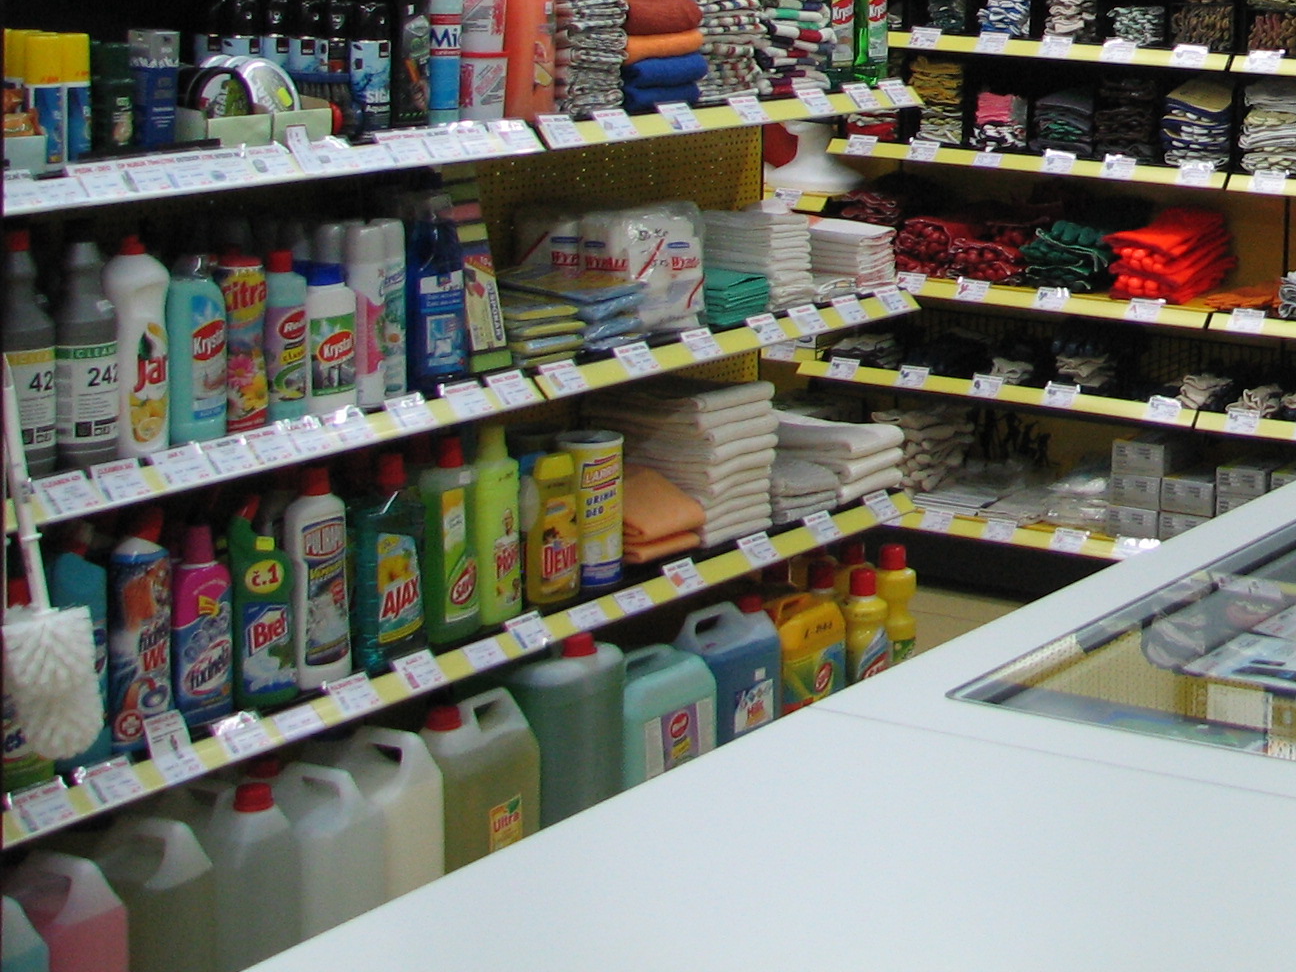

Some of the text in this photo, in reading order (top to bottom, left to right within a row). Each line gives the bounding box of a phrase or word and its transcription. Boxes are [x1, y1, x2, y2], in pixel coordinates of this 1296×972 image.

[252, 563, 280, 587] č.1
[543, 542, 577, 579] DEVIL
[382, 579, 419, 619] AJAX
[254, 607, 286, 650] Bref
